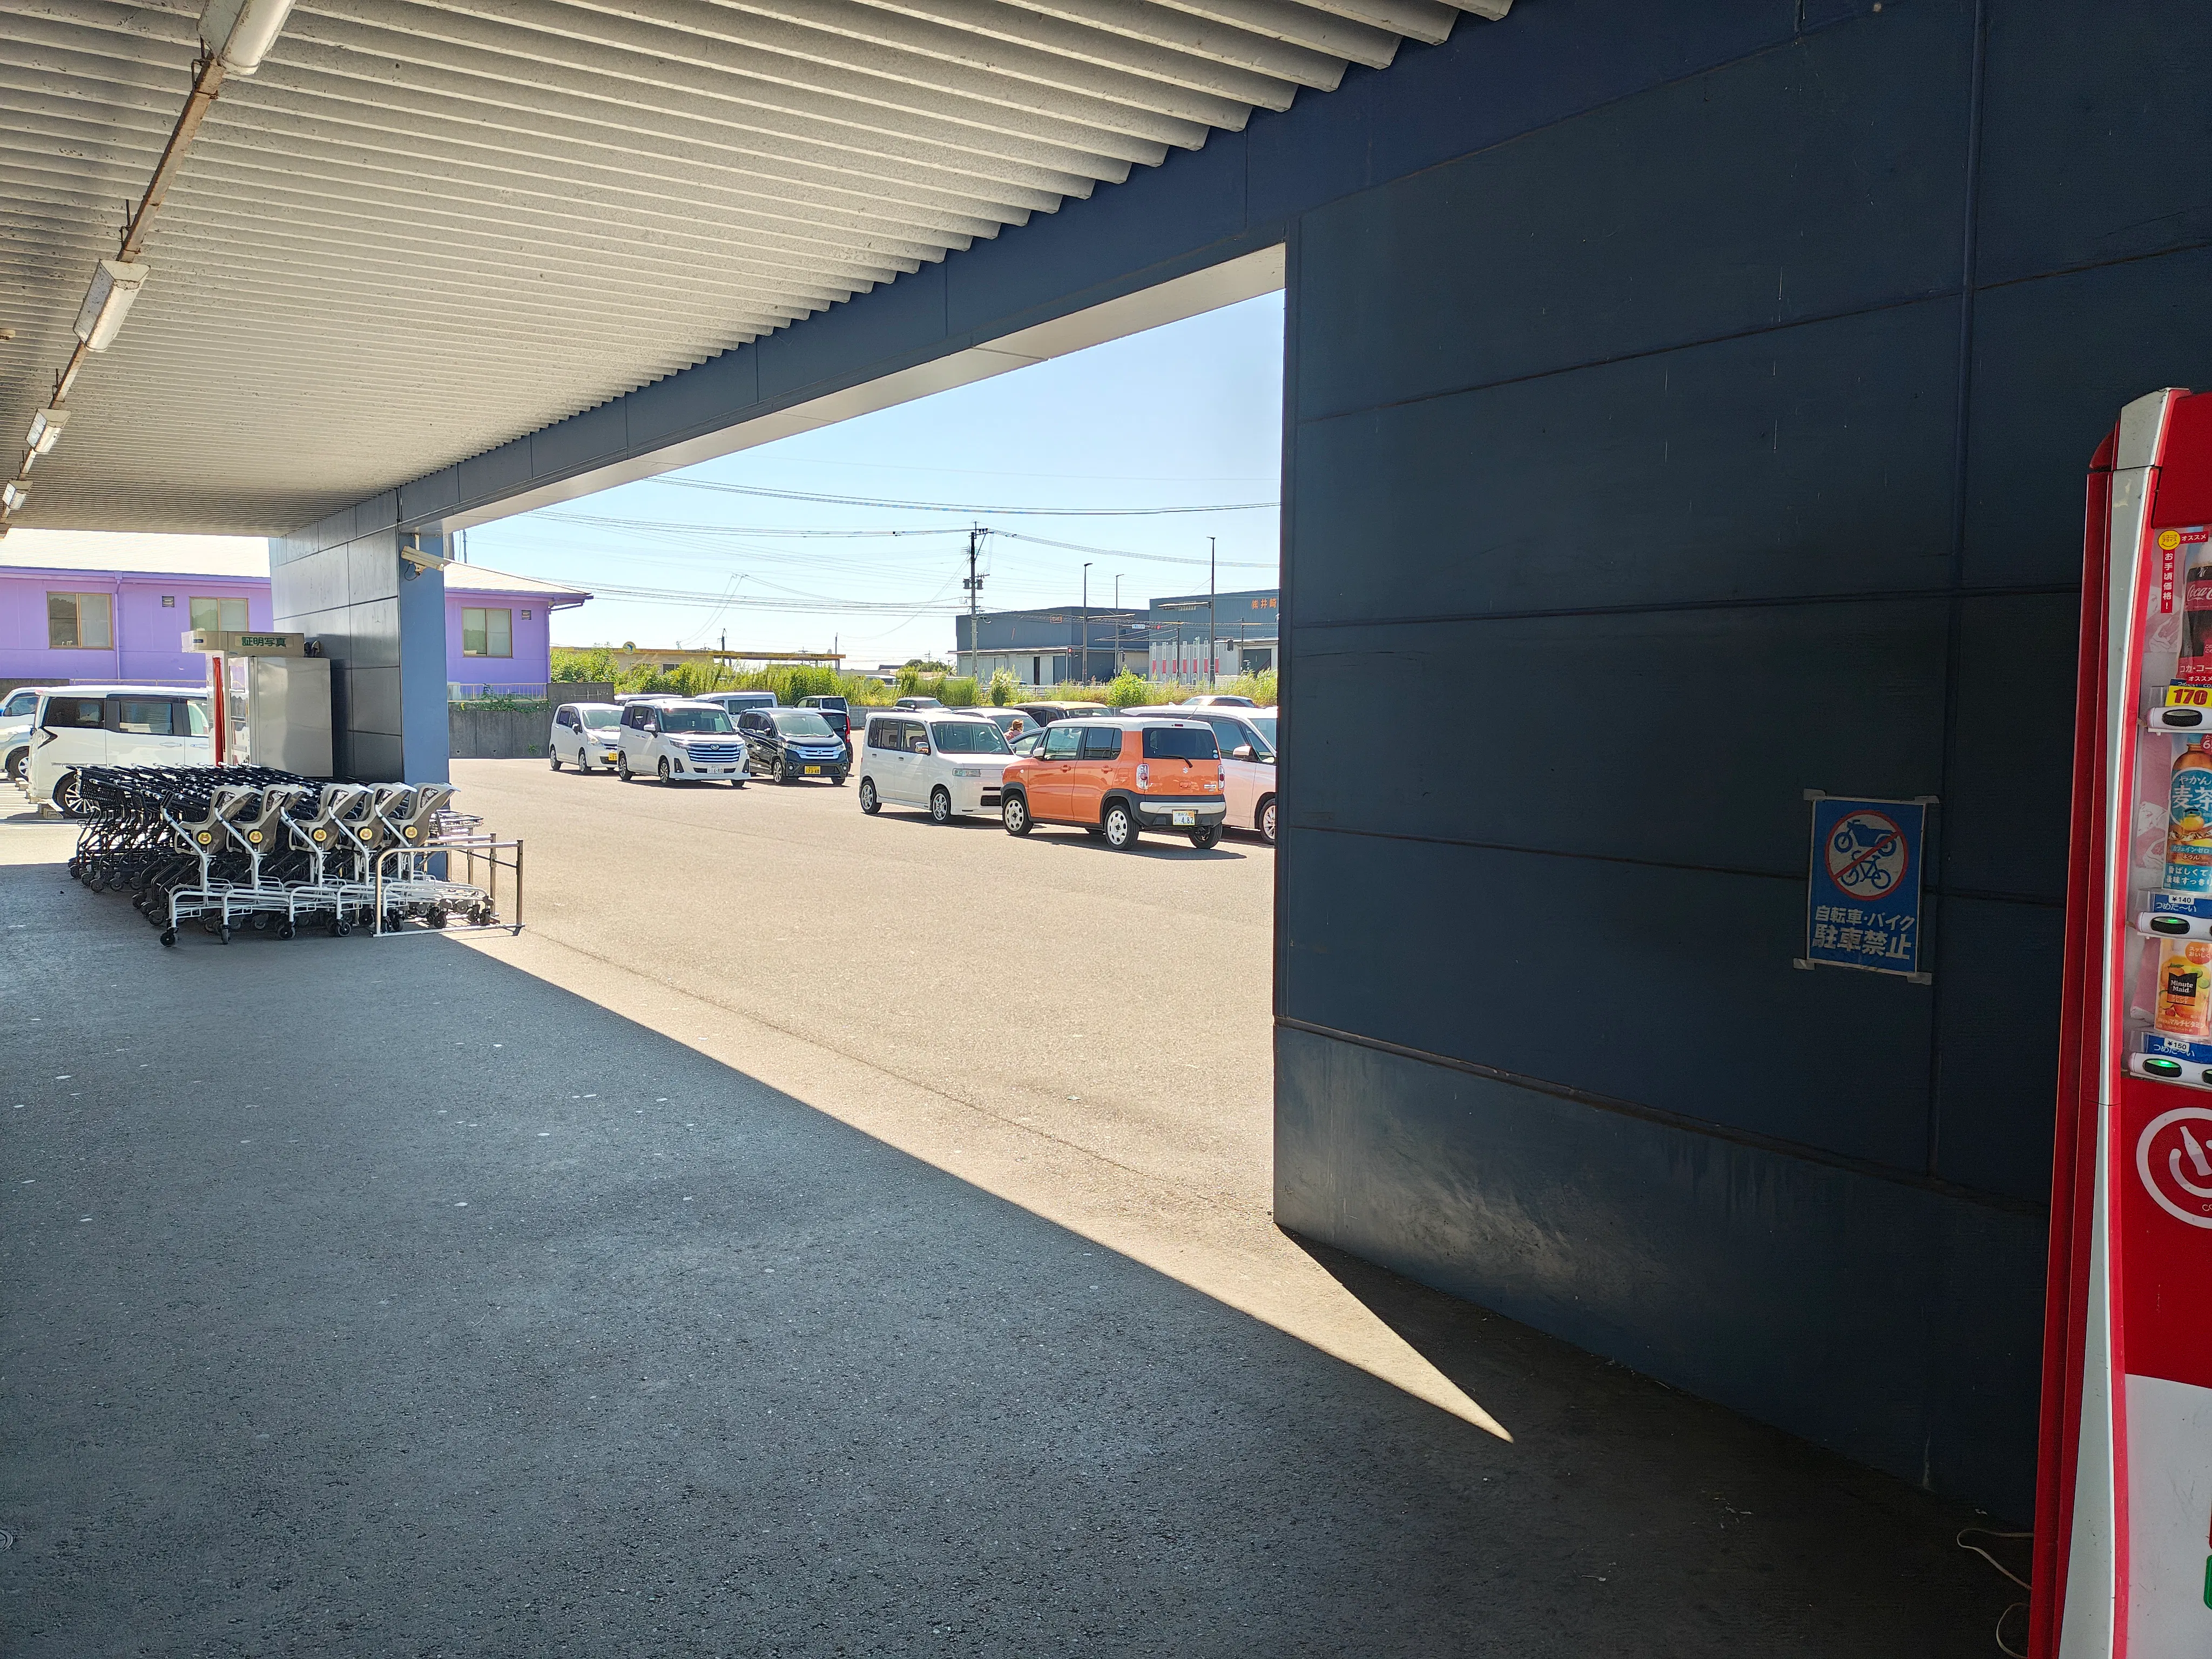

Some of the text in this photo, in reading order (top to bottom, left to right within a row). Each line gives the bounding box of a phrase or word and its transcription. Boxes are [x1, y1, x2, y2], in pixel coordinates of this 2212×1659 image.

[2181, 534, 2207, 542] オススメ
[241, 637, 287, 648] 証明写真
[2174, 689, 2208, 705] 170
[2179, 775, 2212, 785] やかん
[1815, 905, 1916, 932] 自転車・バイク
[1812, 923, 1913, 960] 駐車禁止
[2170, 980, 2194, 988] Minute
[2167, 1040, 2187, 1050] ¥150
